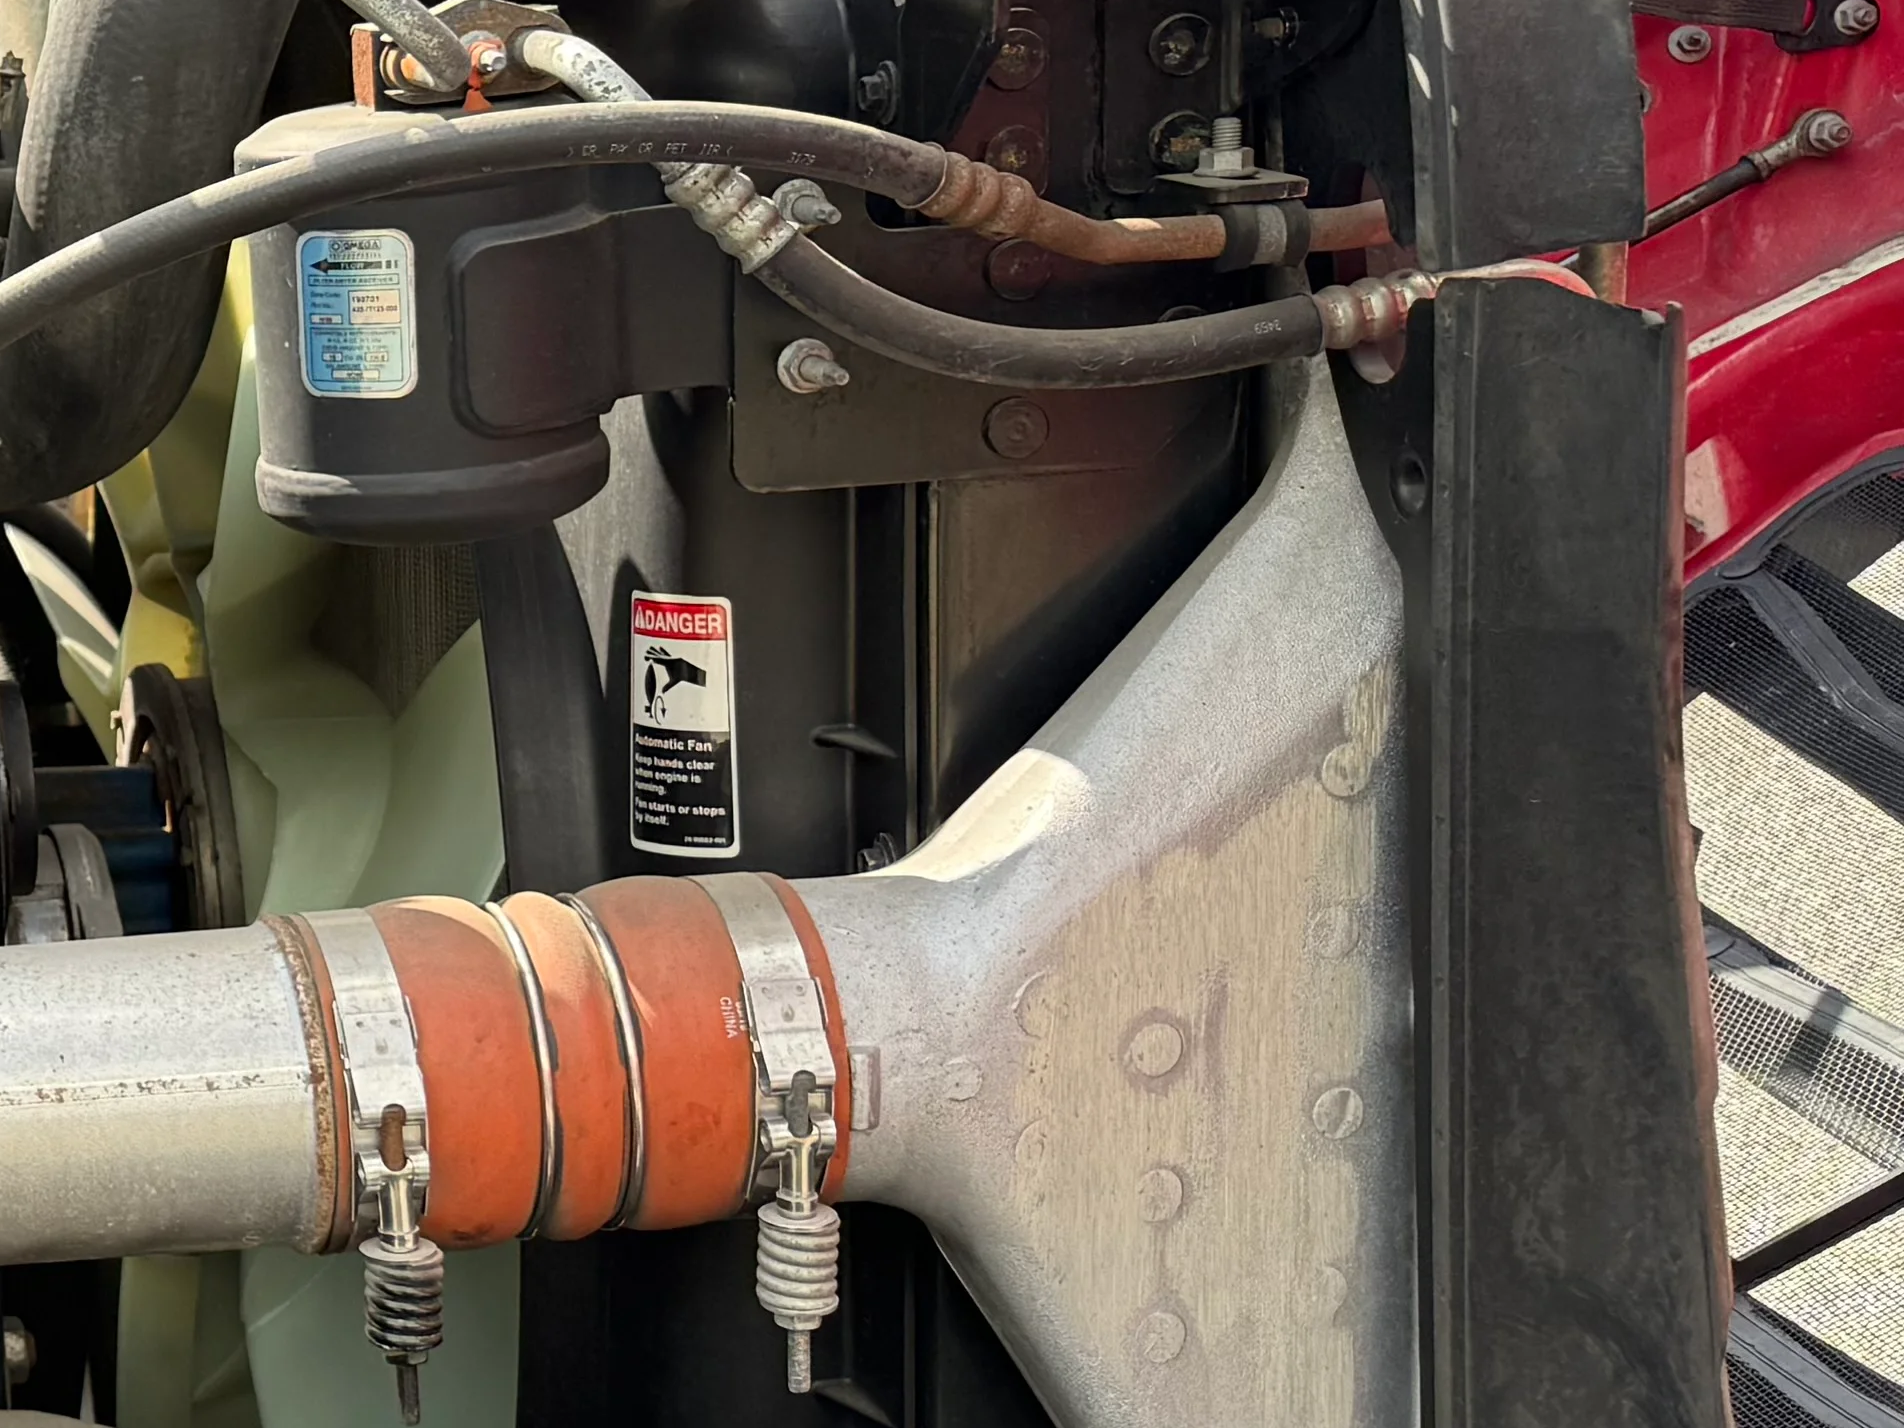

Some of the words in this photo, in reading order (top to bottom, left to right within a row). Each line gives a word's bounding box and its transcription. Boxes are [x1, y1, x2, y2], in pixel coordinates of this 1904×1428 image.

[645, 609, 722, 634] DANGER
[635, 733, 684, 751] Automatic
[687, 739, 713, 752] Fan
[654, 756, 684, 769] hands
[686, 760, 715, 770] clear
[655, 772, 688, 783] engine
[691, 773, 702, 783] is
[648, 801, 676, 813] starts
[678, 806, 690, 814] or
[692, 806, 726, 817] stops
[720, 996, 738, 1039] CHINA
